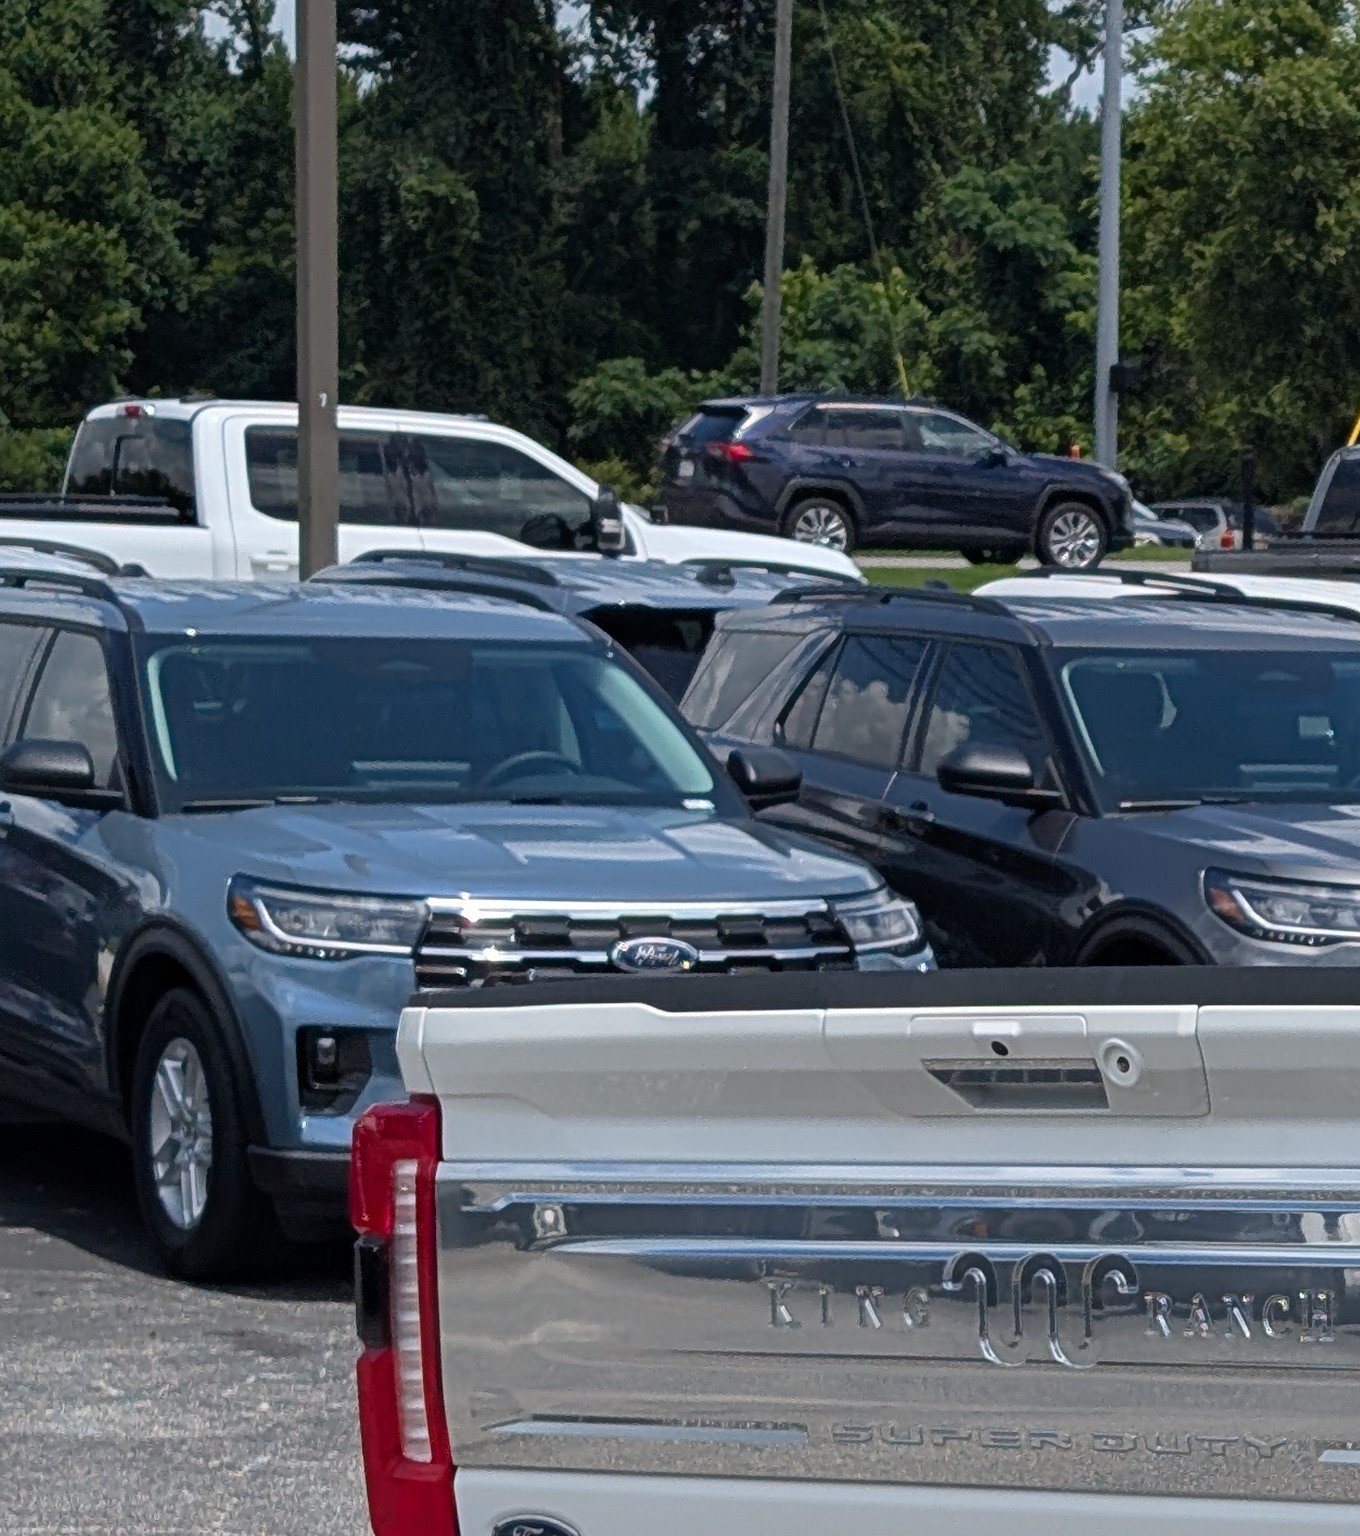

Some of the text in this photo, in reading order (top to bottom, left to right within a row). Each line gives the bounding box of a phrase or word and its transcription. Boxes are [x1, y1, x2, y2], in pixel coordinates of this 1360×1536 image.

[768, 1280, 1337, 1342] KING RANCH
[832, 1422, 1289, 1459] SUPER DUTY
